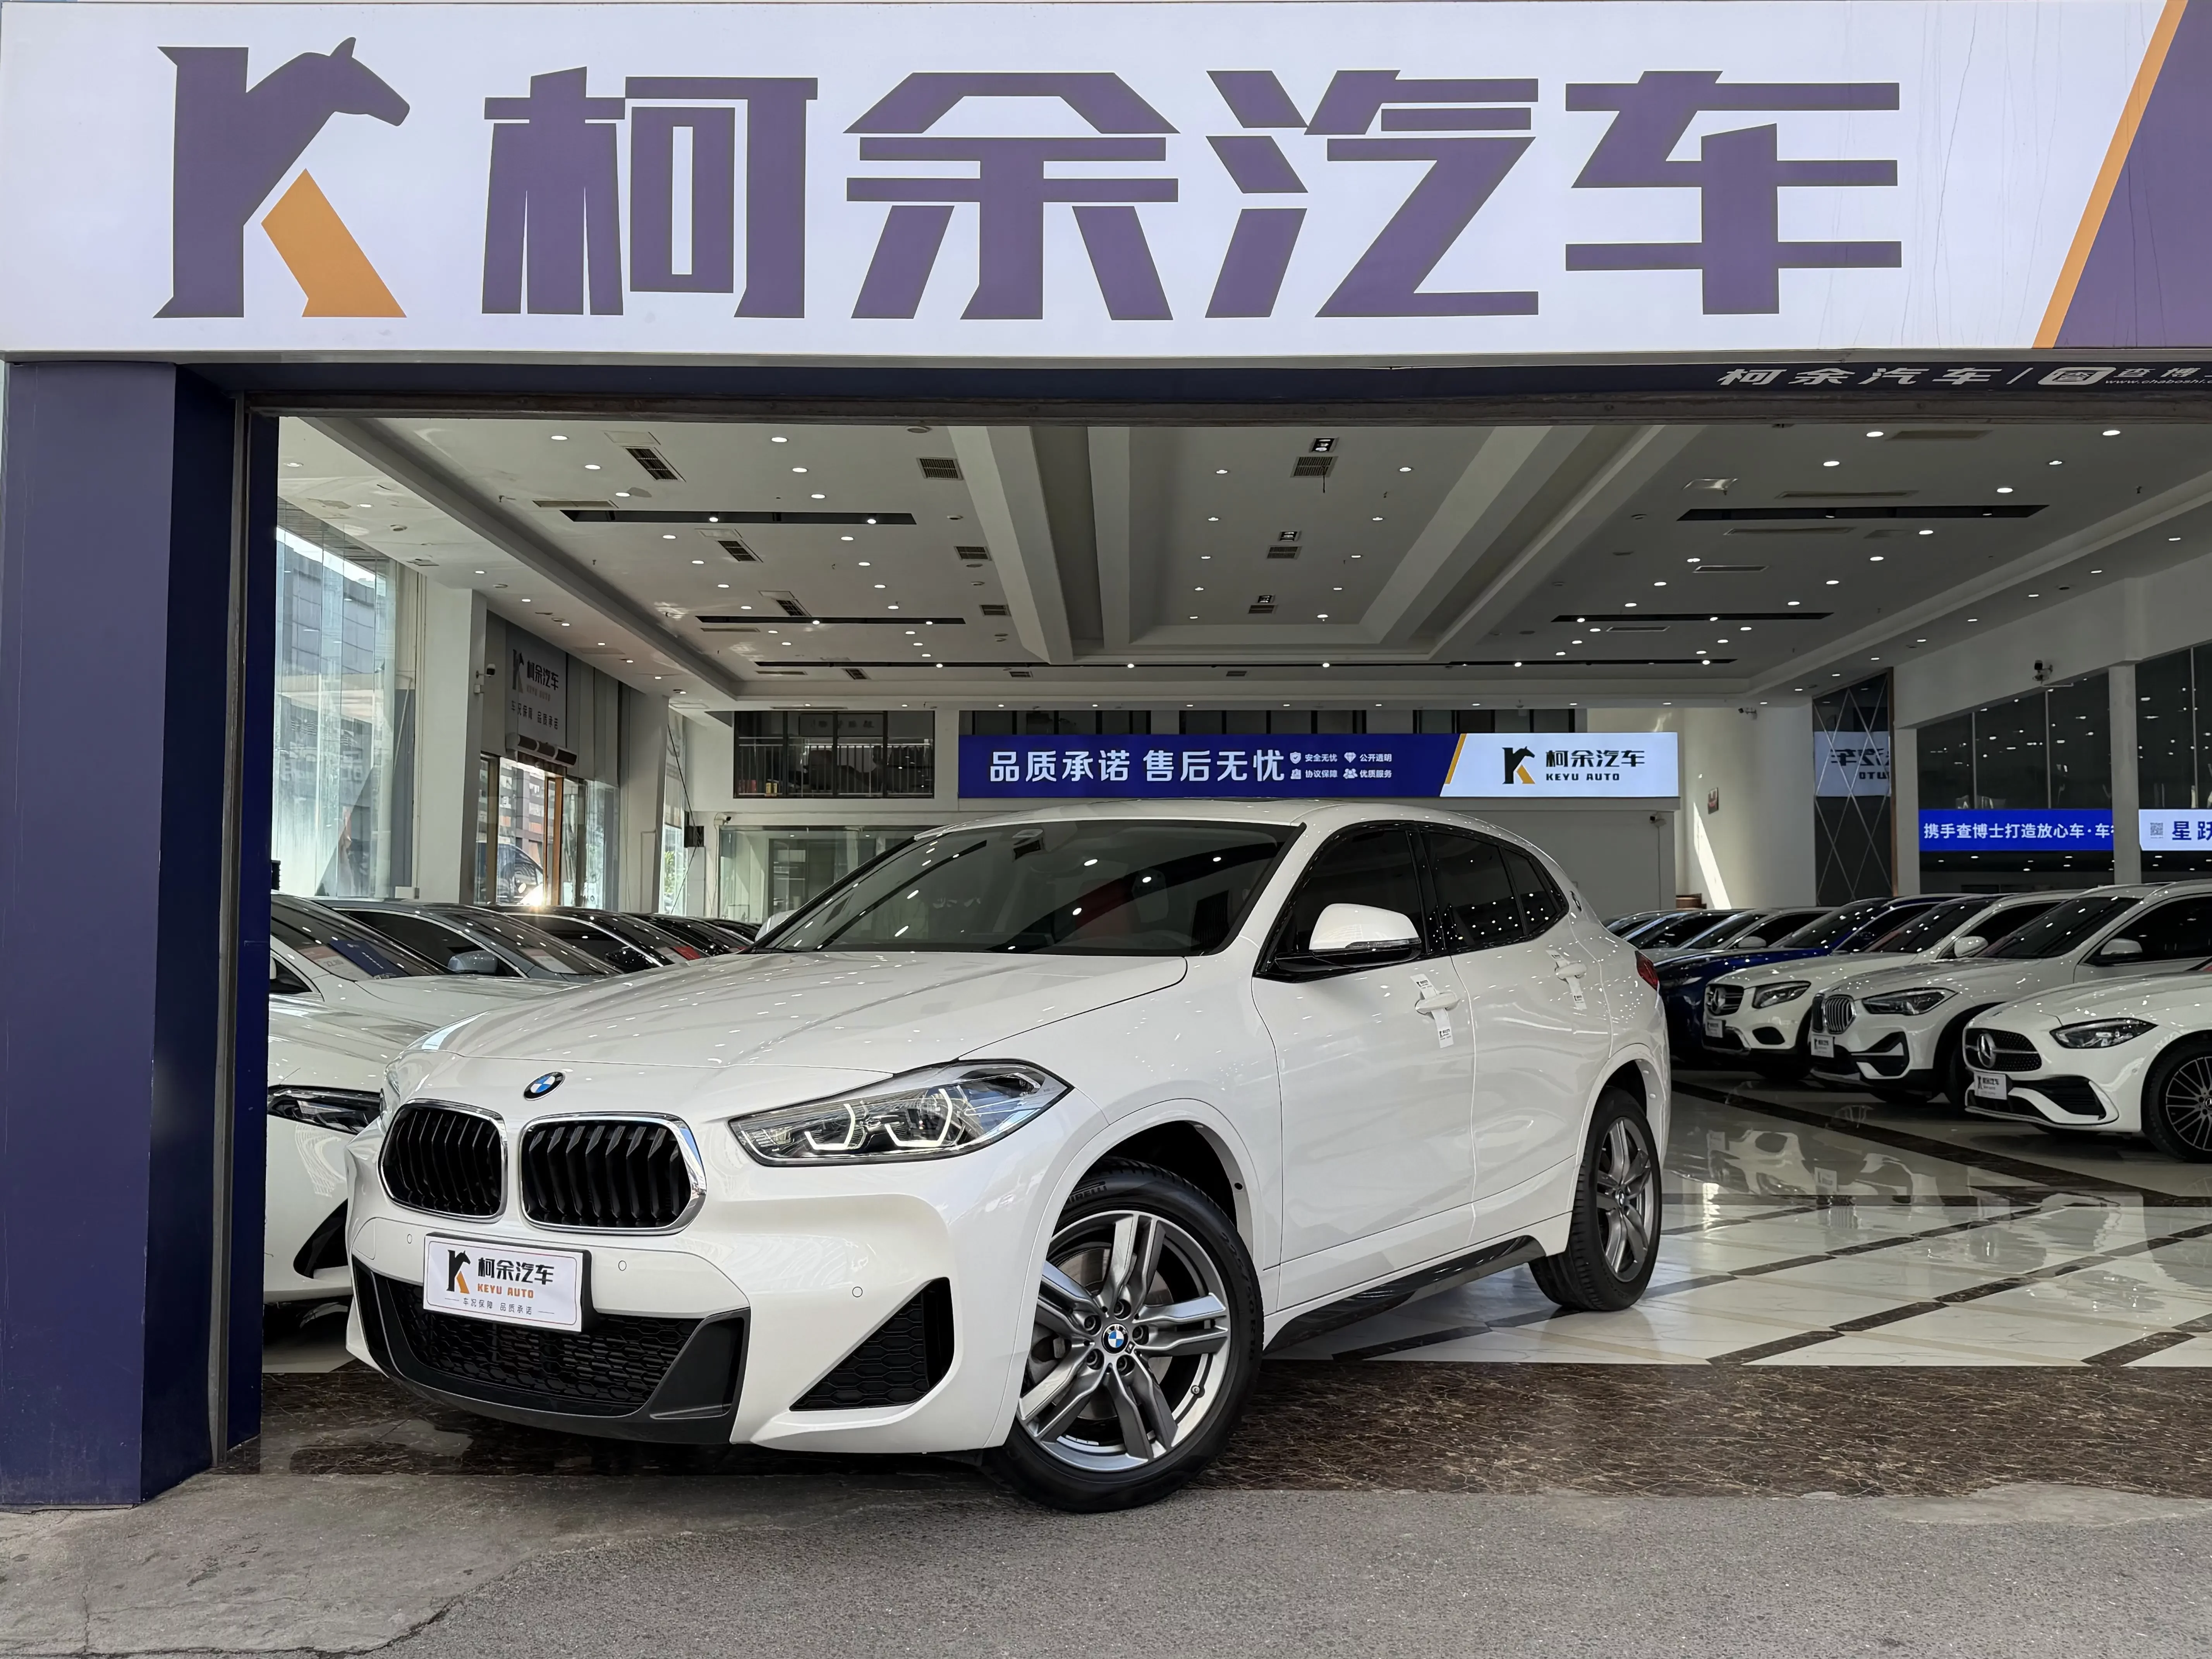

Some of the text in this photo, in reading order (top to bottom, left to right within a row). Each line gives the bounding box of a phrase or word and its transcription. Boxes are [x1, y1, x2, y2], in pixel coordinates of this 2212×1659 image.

[482, 67, 1902, 320] 柯余汽车
[989, 749, 1285, 782] 品质承诺 售后无忧
[1305, 754, 1392, 762] 安全无忧 公开透明
[1546, 750, 1645, 767] 柯余汽车
[1305, 769, 1392, 778] 协议保障 优质服务
[1546, 773, 1620, 781] KEYU AUTO
[477, 1257, 554, 1285] 柯余汽车
[477, 1283, 534, 1298] KEYU AUTO
[463, 1297, 532, 1315] 车况保障 品质承诺
